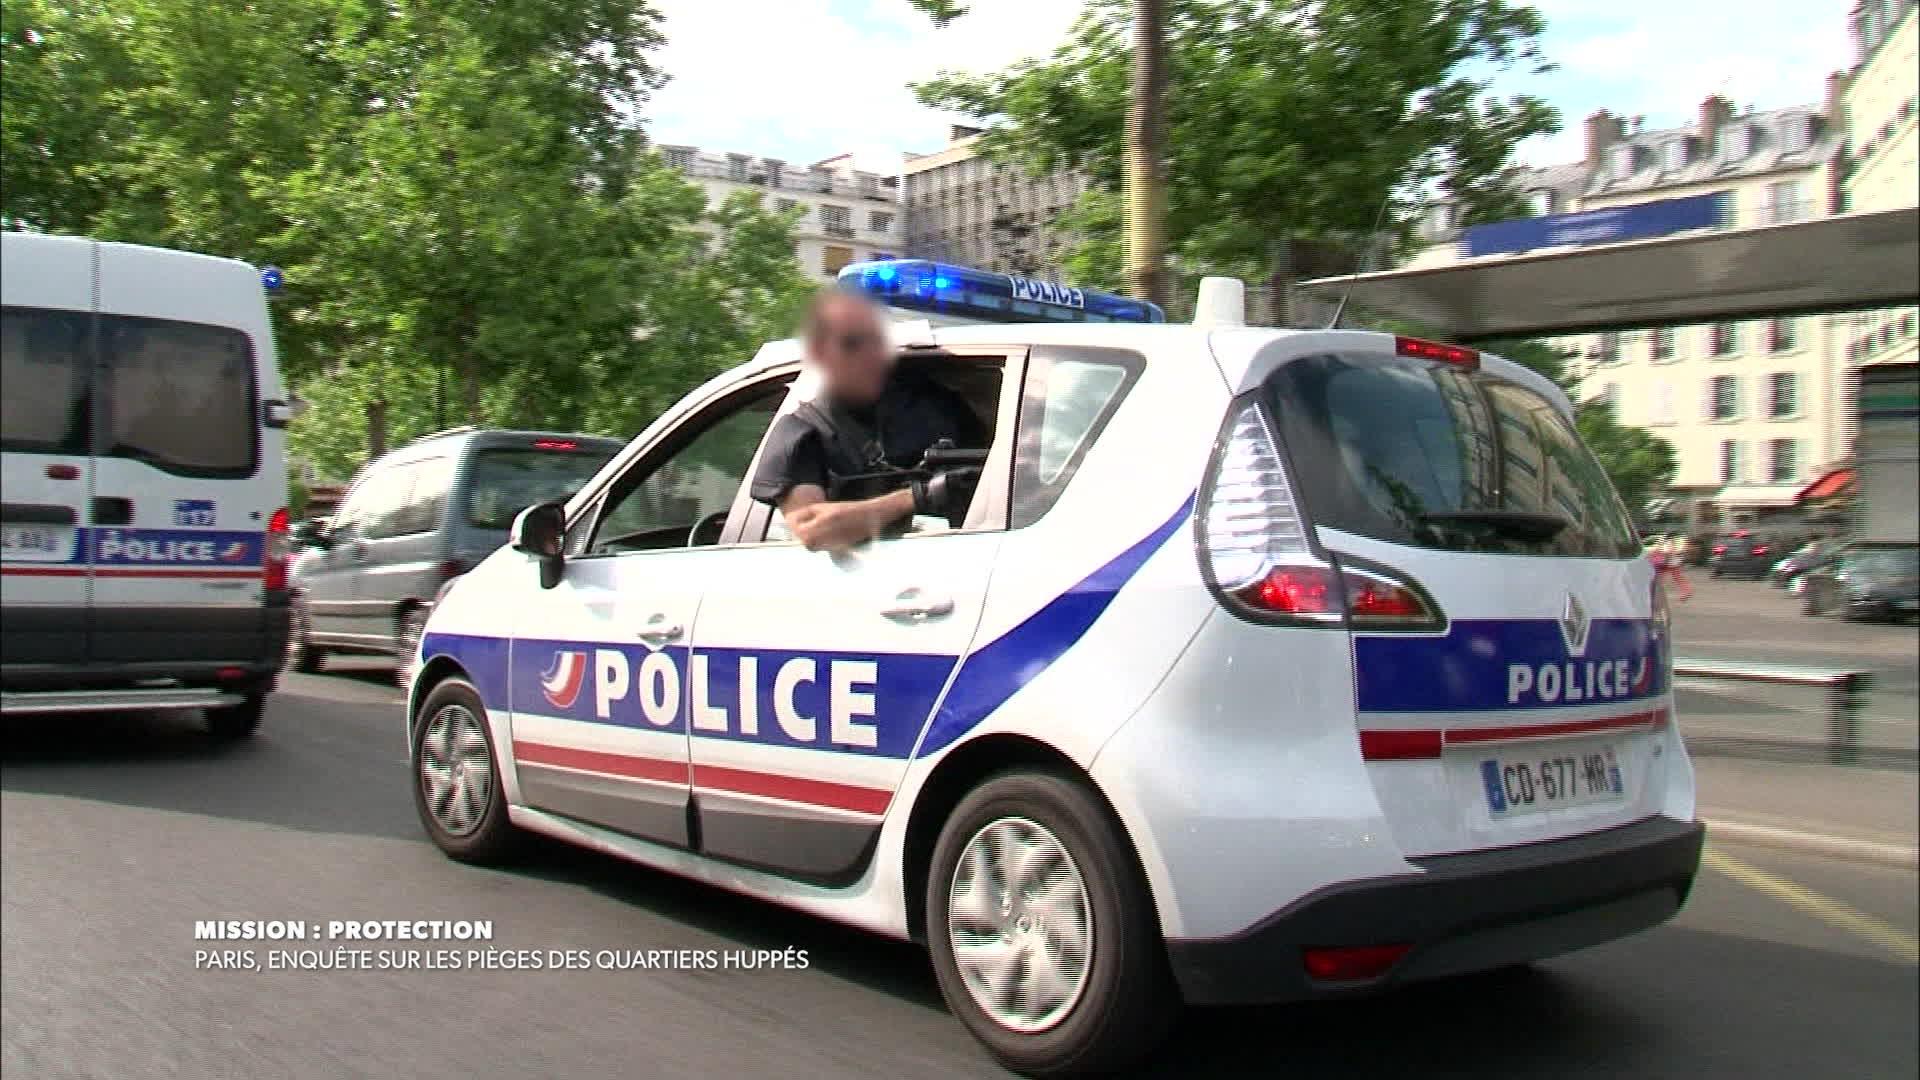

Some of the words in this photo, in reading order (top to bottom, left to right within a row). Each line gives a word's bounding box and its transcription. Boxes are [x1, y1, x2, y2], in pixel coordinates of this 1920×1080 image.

[1011, 276, 1083, 307] POLICE
[101, 541, 216, 562] POLICE
[595, 648, 878, 747] POLICE
[1507, 659, 1630, 704] POLICE
